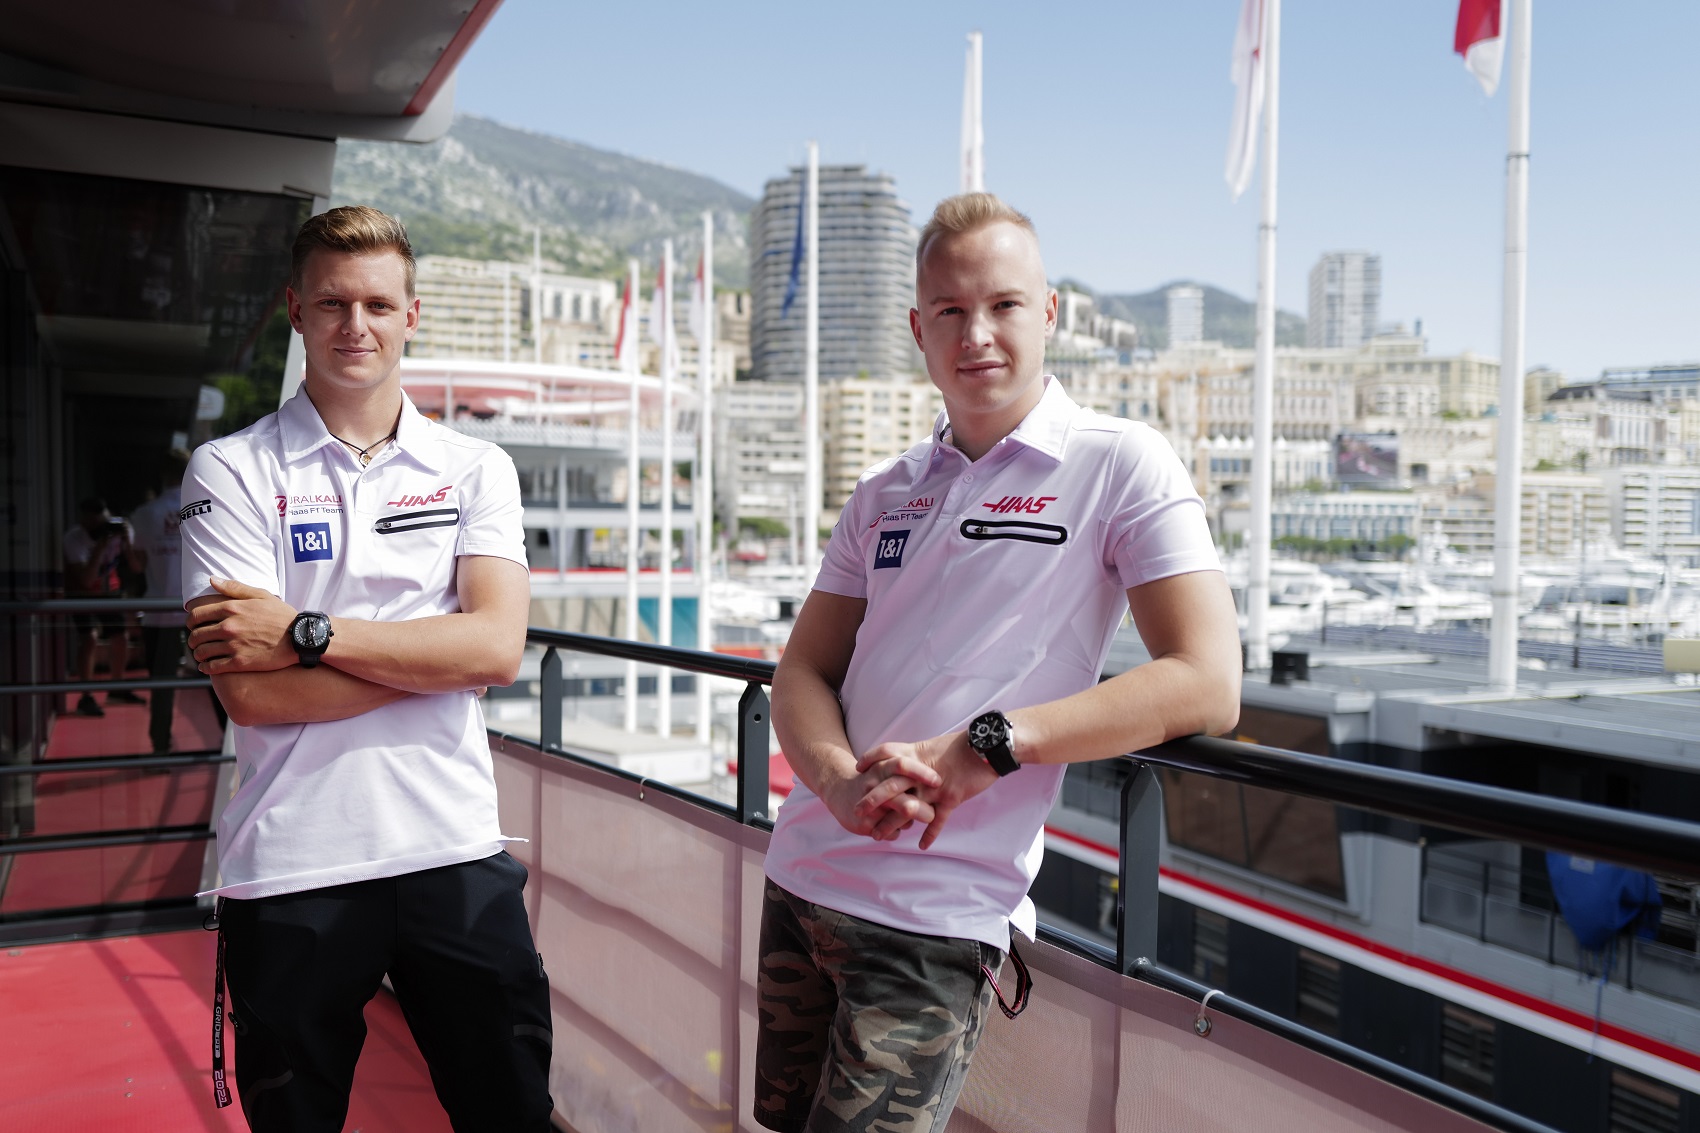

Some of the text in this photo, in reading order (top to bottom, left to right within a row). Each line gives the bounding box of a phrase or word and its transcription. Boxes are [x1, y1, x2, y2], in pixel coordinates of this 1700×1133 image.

[387, 485, 453, 508] HAAS
[981, 495, 1059, 514] HAAS
[321, 506, 344, 514] Team
[294, 530, 329, 552] 1&1
[878, 537, 905, 559] 1&1
[214, 1069, 227, 1108] 2021
